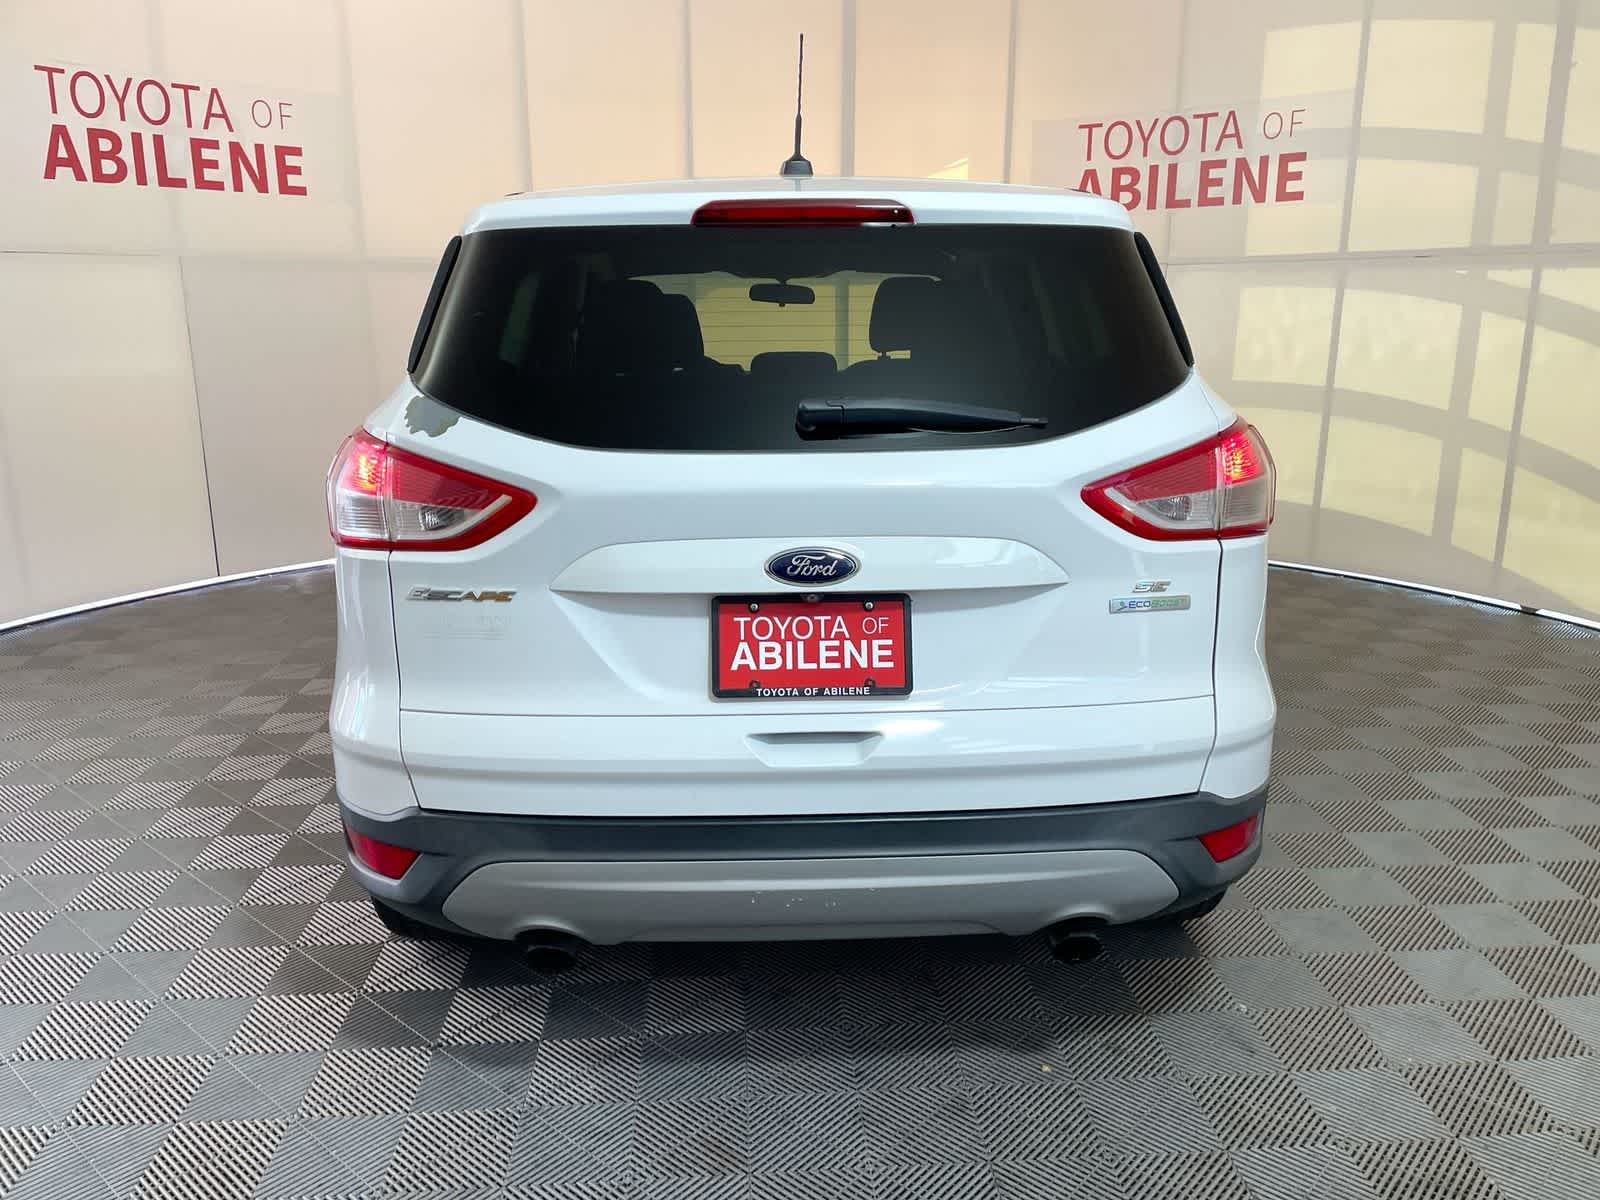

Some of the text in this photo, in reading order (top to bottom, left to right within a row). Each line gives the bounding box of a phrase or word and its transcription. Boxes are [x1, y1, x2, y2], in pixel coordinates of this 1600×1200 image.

[34, 64, 293, 133] TOYOTA OF
[1078, 109, 1306, 161] TOYOTA OF
[43, 123, 308, 196] ABILENE
[1077, 151, 1308, 212] ABILENE
[786, 554, 839, 577] Ford
[733, 615, 889, 640] TOYOTA OF
[730, 639, 895, 671] ABILENE
[756, 686, 871, 697] TOYOTA OF ABILENE
